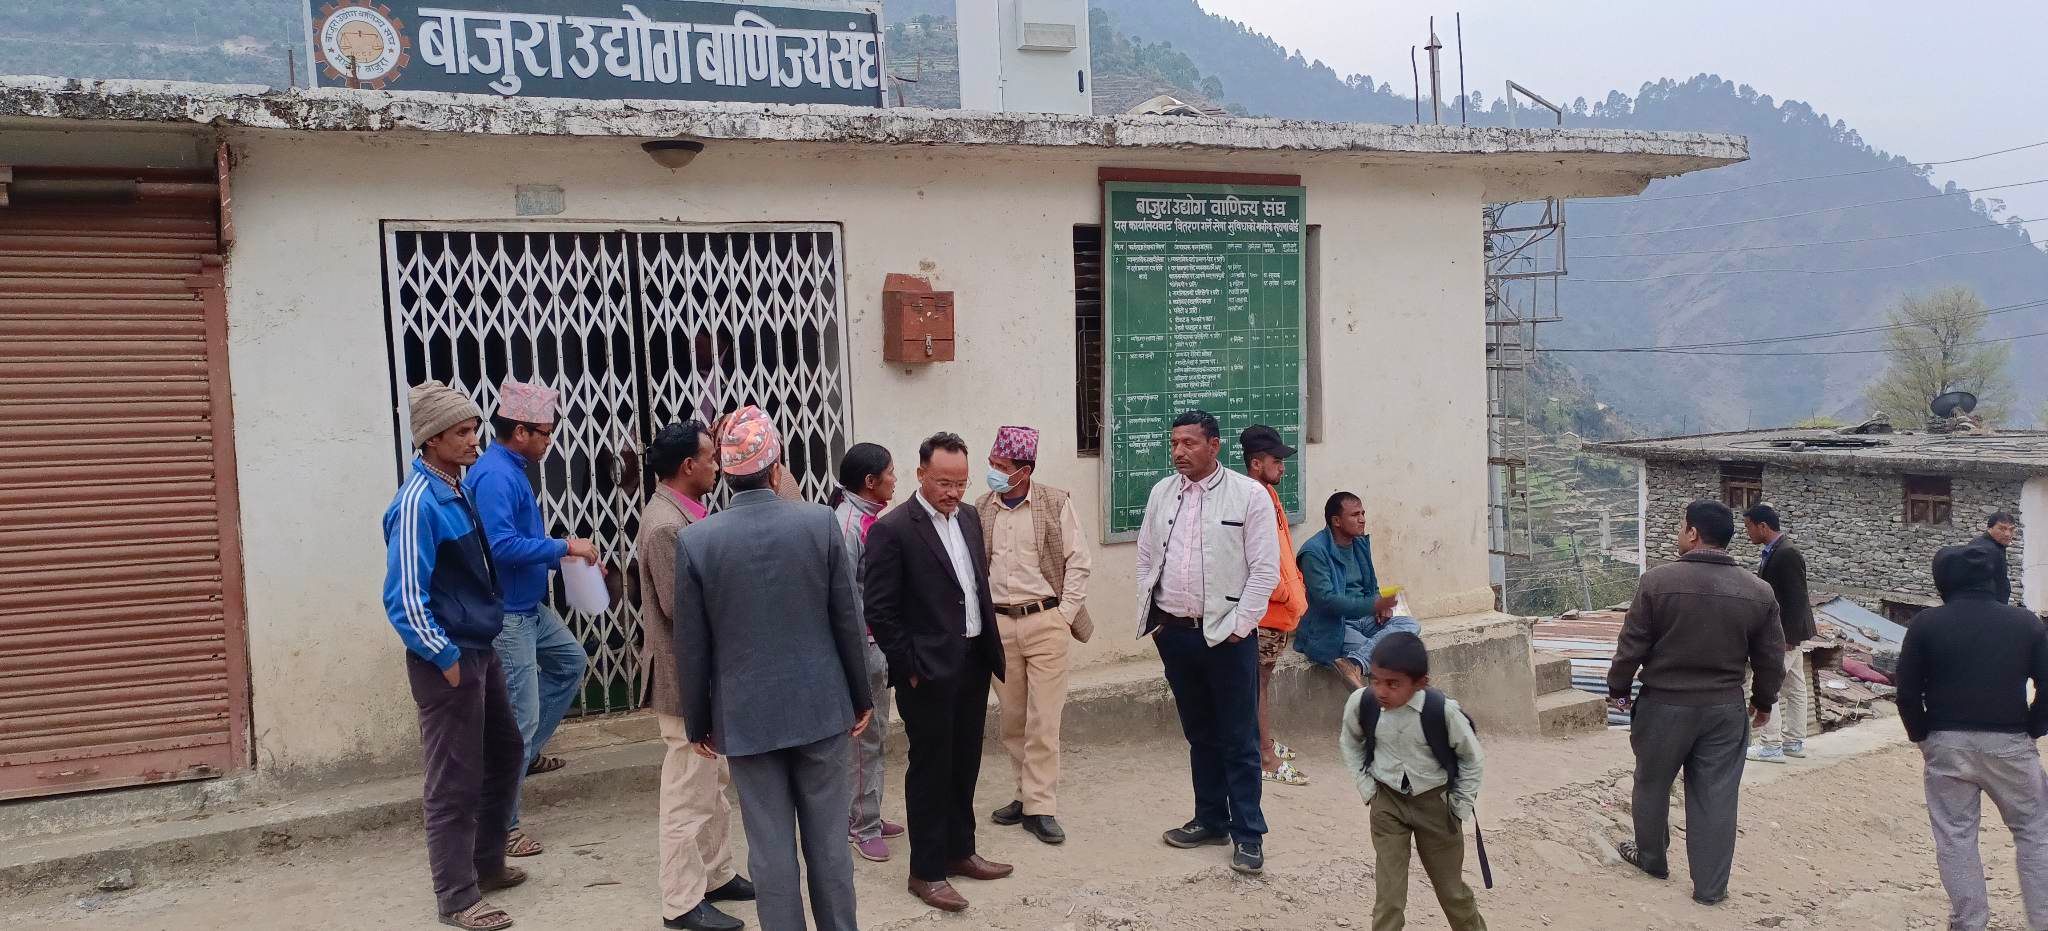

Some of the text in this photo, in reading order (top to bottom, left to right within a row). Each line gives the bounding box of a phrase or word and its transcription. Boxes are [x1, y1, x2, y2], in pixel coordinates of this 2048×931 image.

[418, 7, 563, 95] बाजुरा
[564, 4, 692, 84] उद्योग
[829, 21, 879, 91] संघ
[1136, 198, 1171, 219] बाजुरा
[1172, 194, 1207, 216] उद्योग
[1262, 197, 1287, 217] संघ
[1114, 220, 1127, 233] यस
[1174, 217, 1200, 233] वितरण
